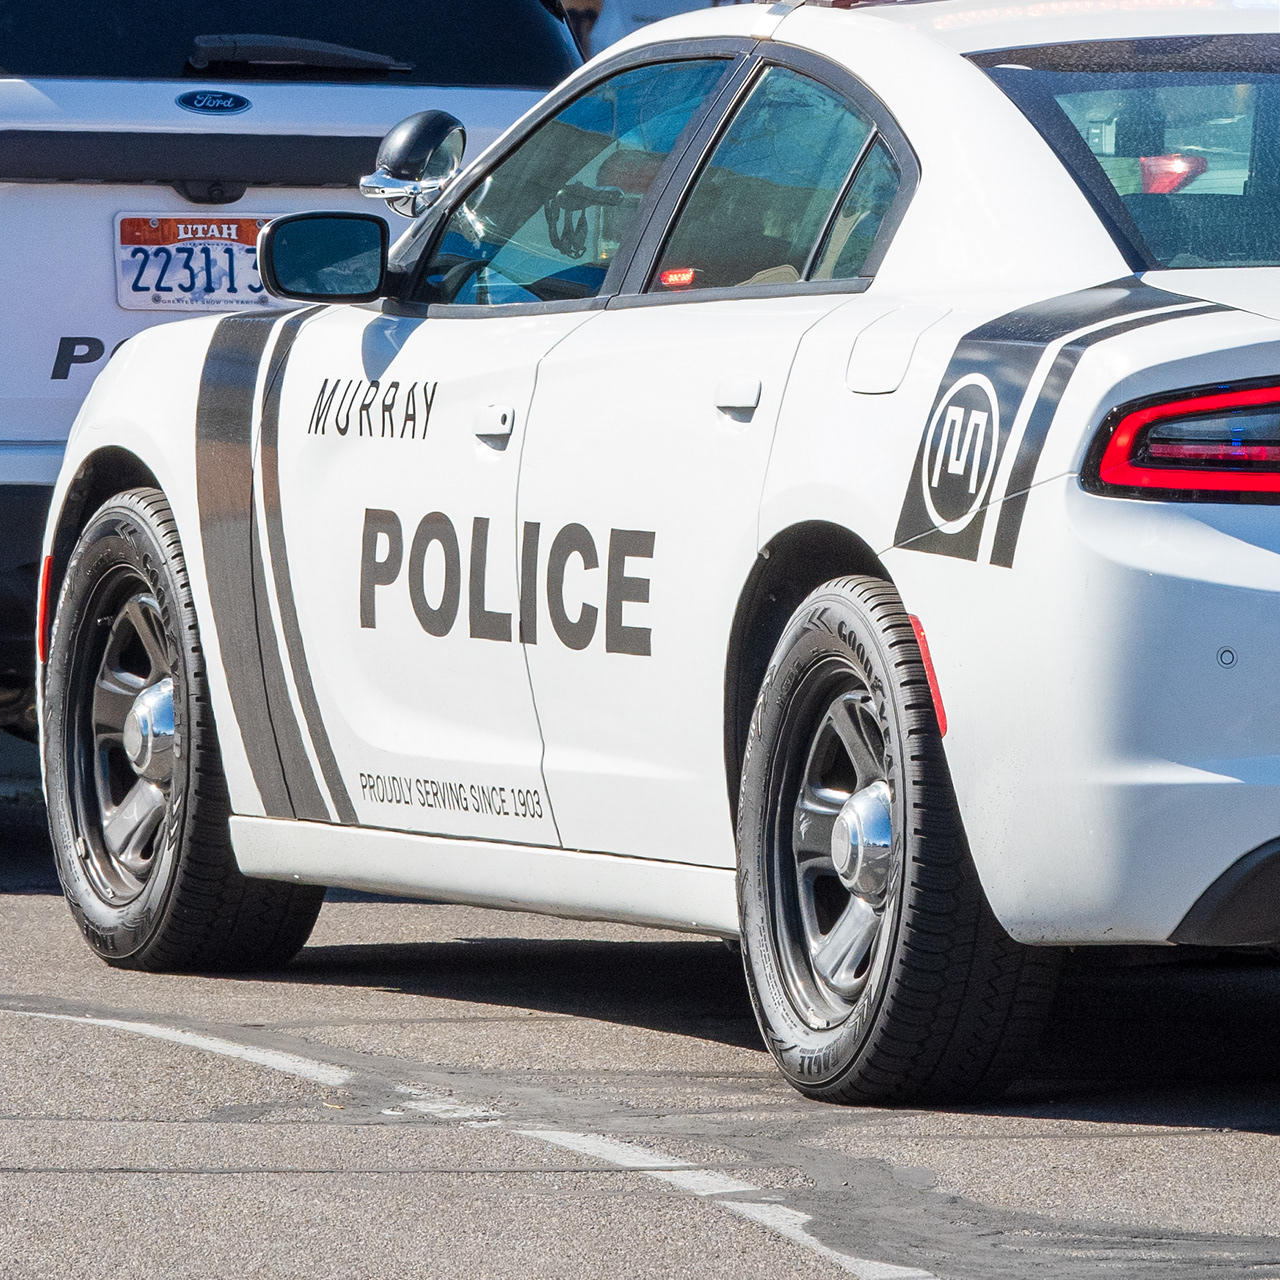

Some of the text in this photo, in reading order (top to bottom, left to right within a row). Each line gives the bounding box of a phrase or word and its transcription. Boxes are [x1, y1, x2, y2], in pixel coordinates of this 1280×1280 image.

[194, 94, 235, 108] Ford
[177, 224, 239, 240] UTAH
[308, 378, 438, 440] MURRAY
[360, 508, 656, 657] POLICE
[359, 772, 544, 819] PROUDLY SERVING SINCE 1903
